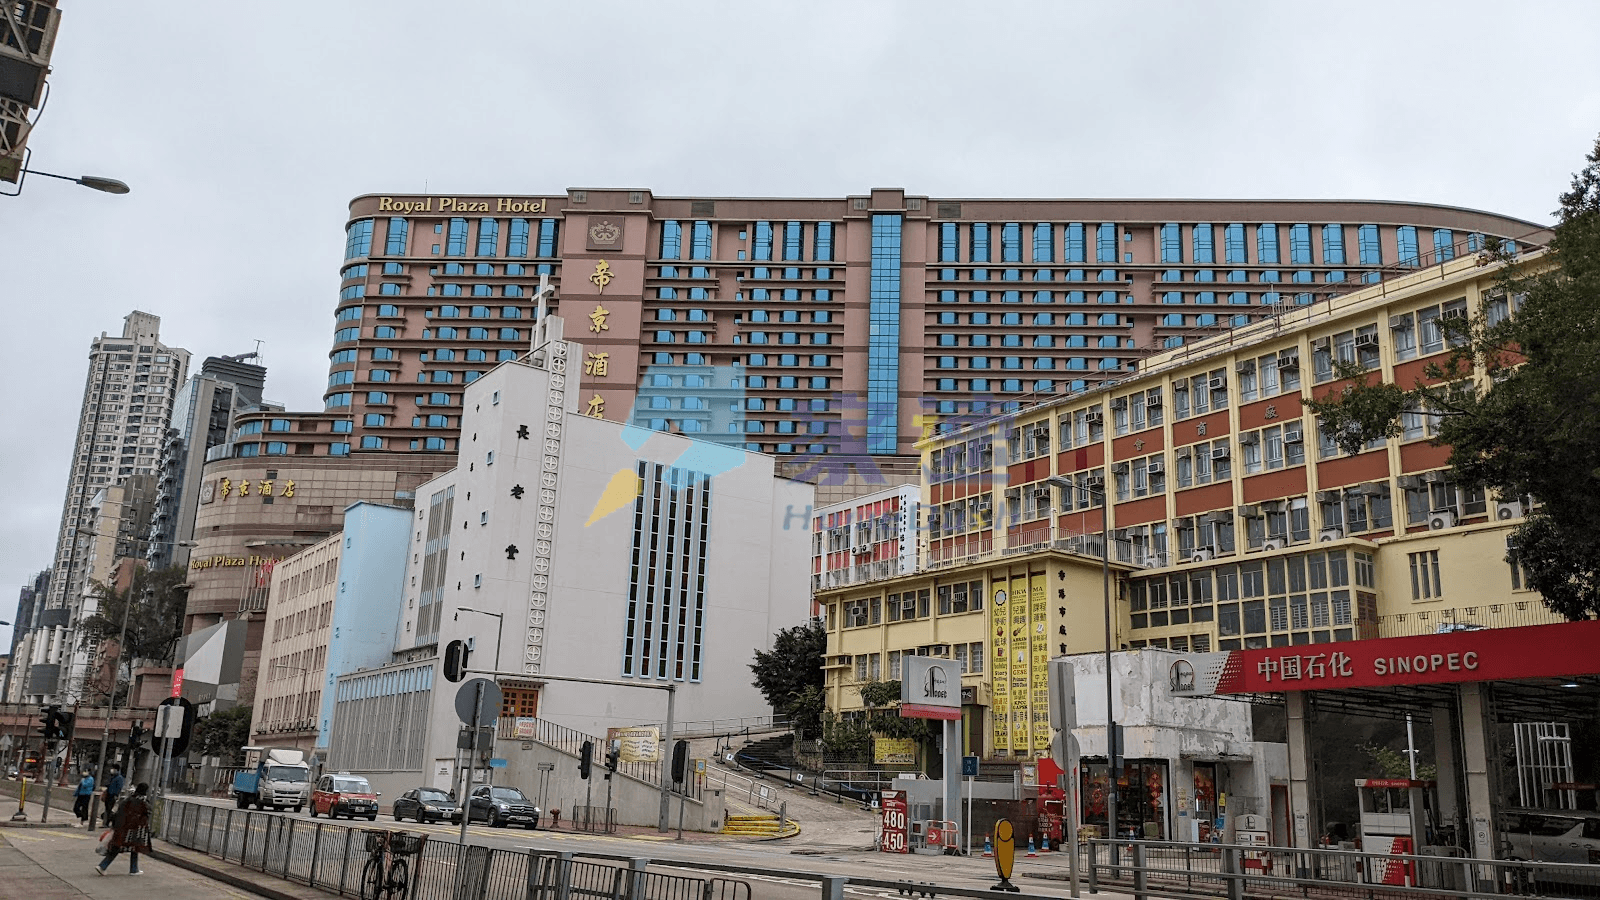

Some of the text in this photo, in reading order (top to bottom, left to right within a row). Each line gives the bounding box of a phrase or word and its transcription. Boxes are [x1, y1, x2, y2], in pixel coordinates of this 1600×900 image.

[378, 196, 547, 215] Royal Plaza Hotel
[584, 259, 614, 419] 帝京酒店
[221, 479, 295, 500] 帝京酒店
[191, 557, 213, 570] Royal
[214, 555, 245, 567] Plaza
[1258, 652, 1353, 682] 中国石化
[1374, 652, 1478, 675] SINOPEC
[884, 810, 905, 829] 480
[884, 832, 904, 850] 450
